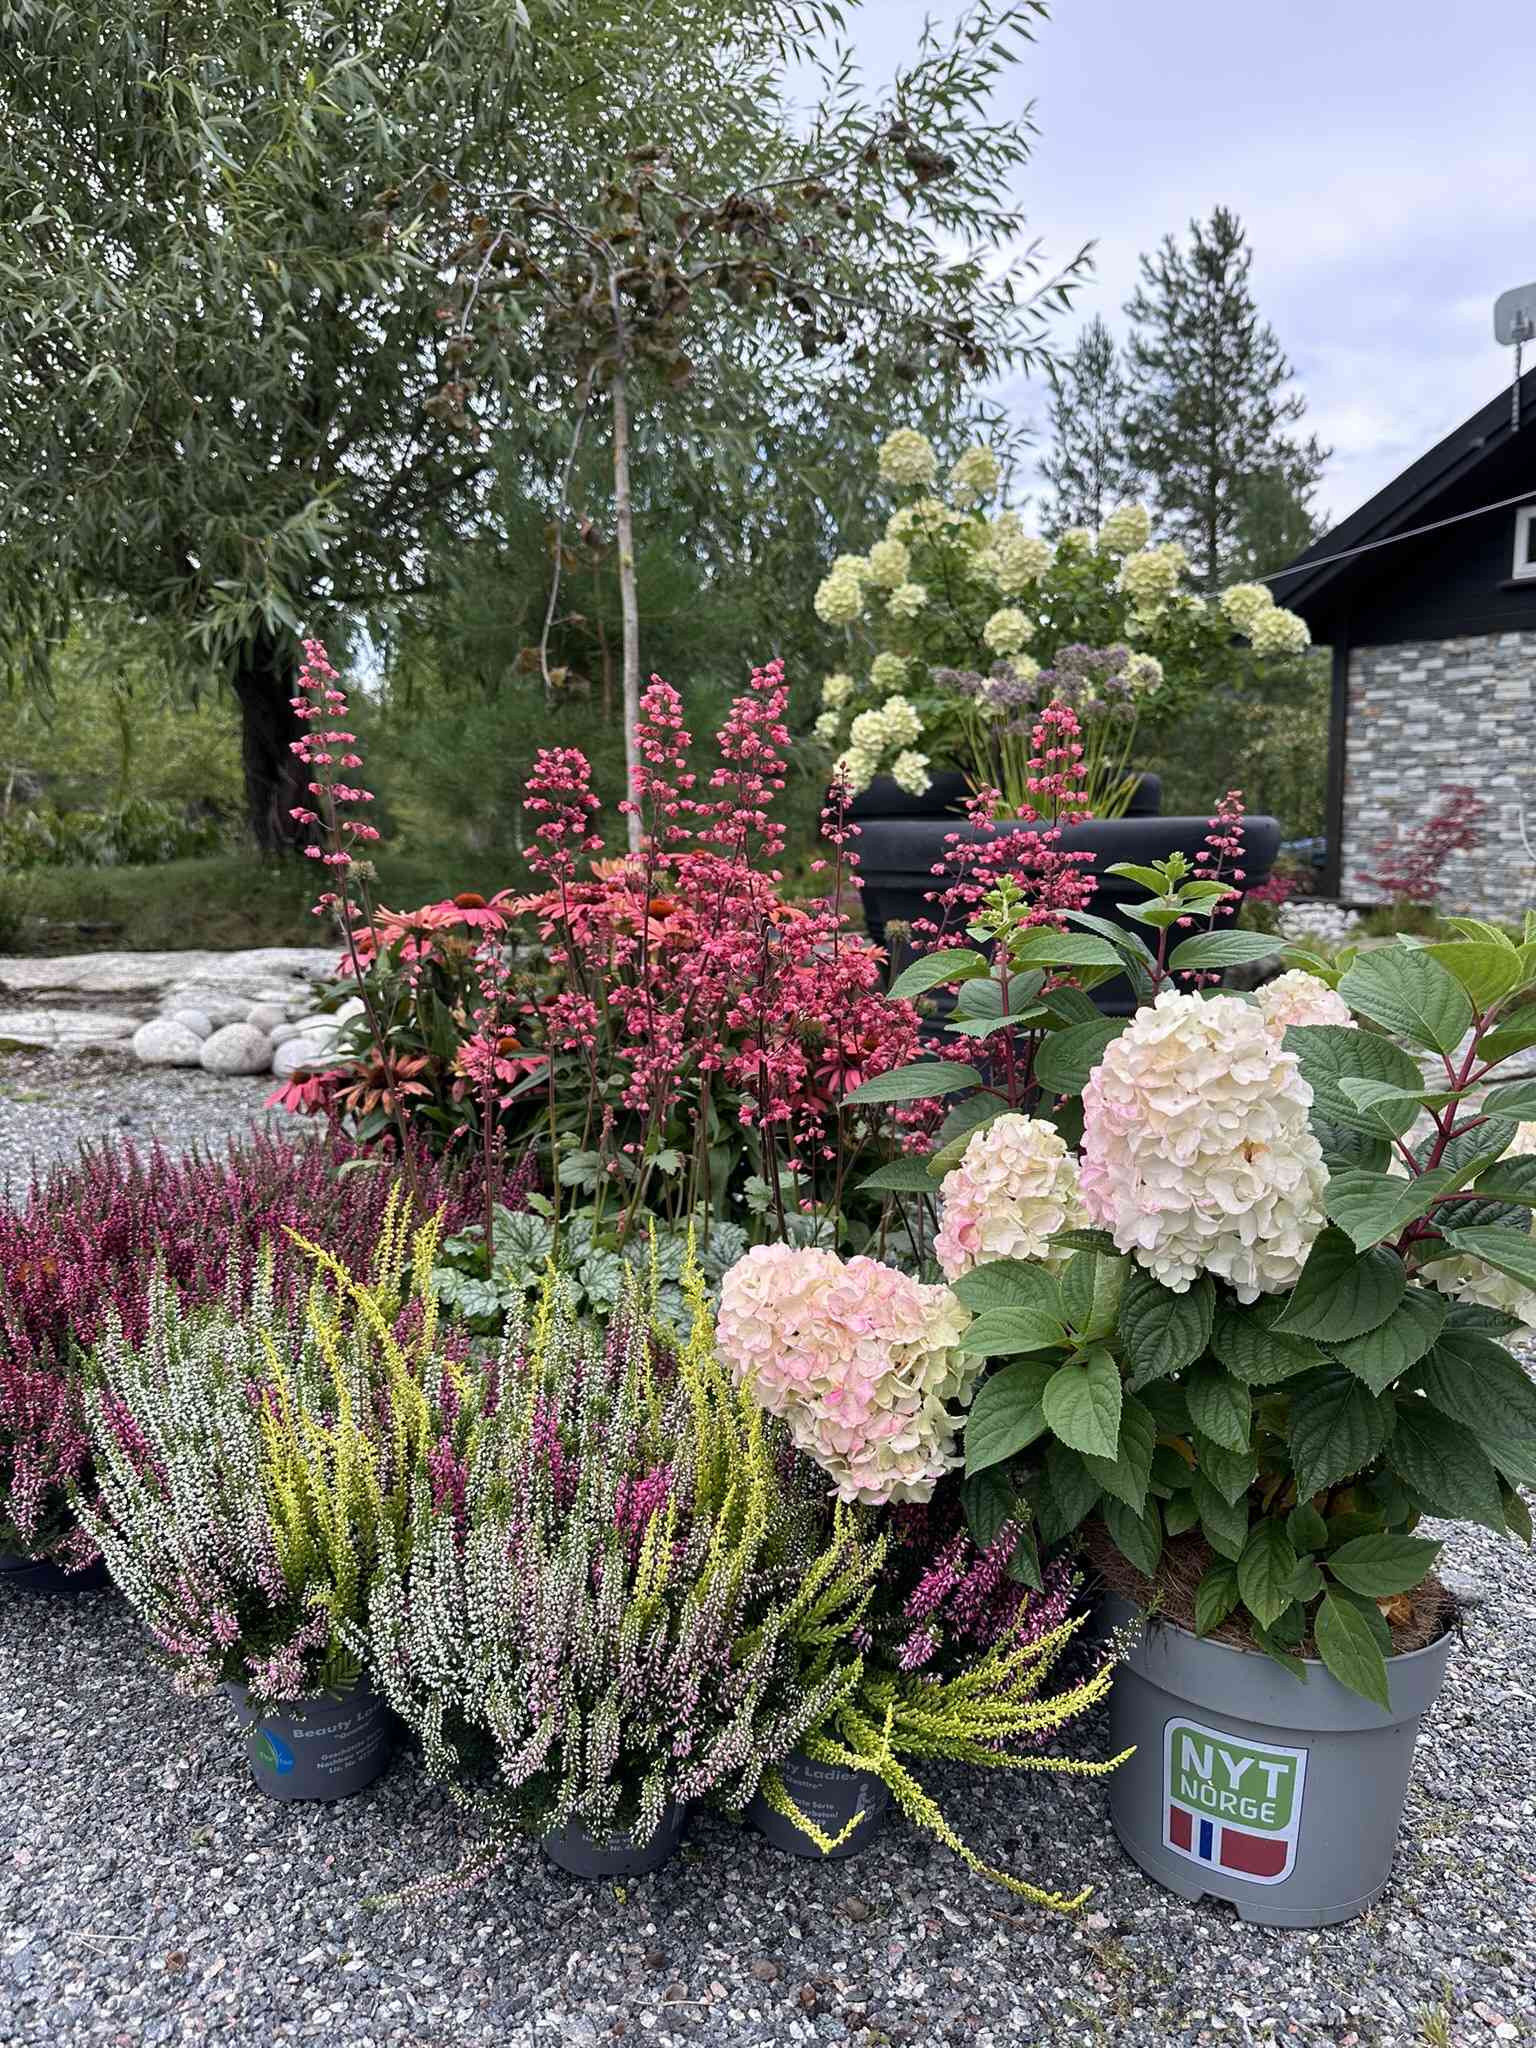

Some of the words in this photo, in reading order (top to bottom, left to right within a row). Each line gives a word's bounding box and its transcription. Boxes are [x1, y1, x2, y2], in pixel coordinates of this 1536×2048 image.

[292, 1719, 352, 1739] Beauty
[1181, 1734, 1289, 1799] NYT
[1181, 1773, 1277, 1824] NORGE
